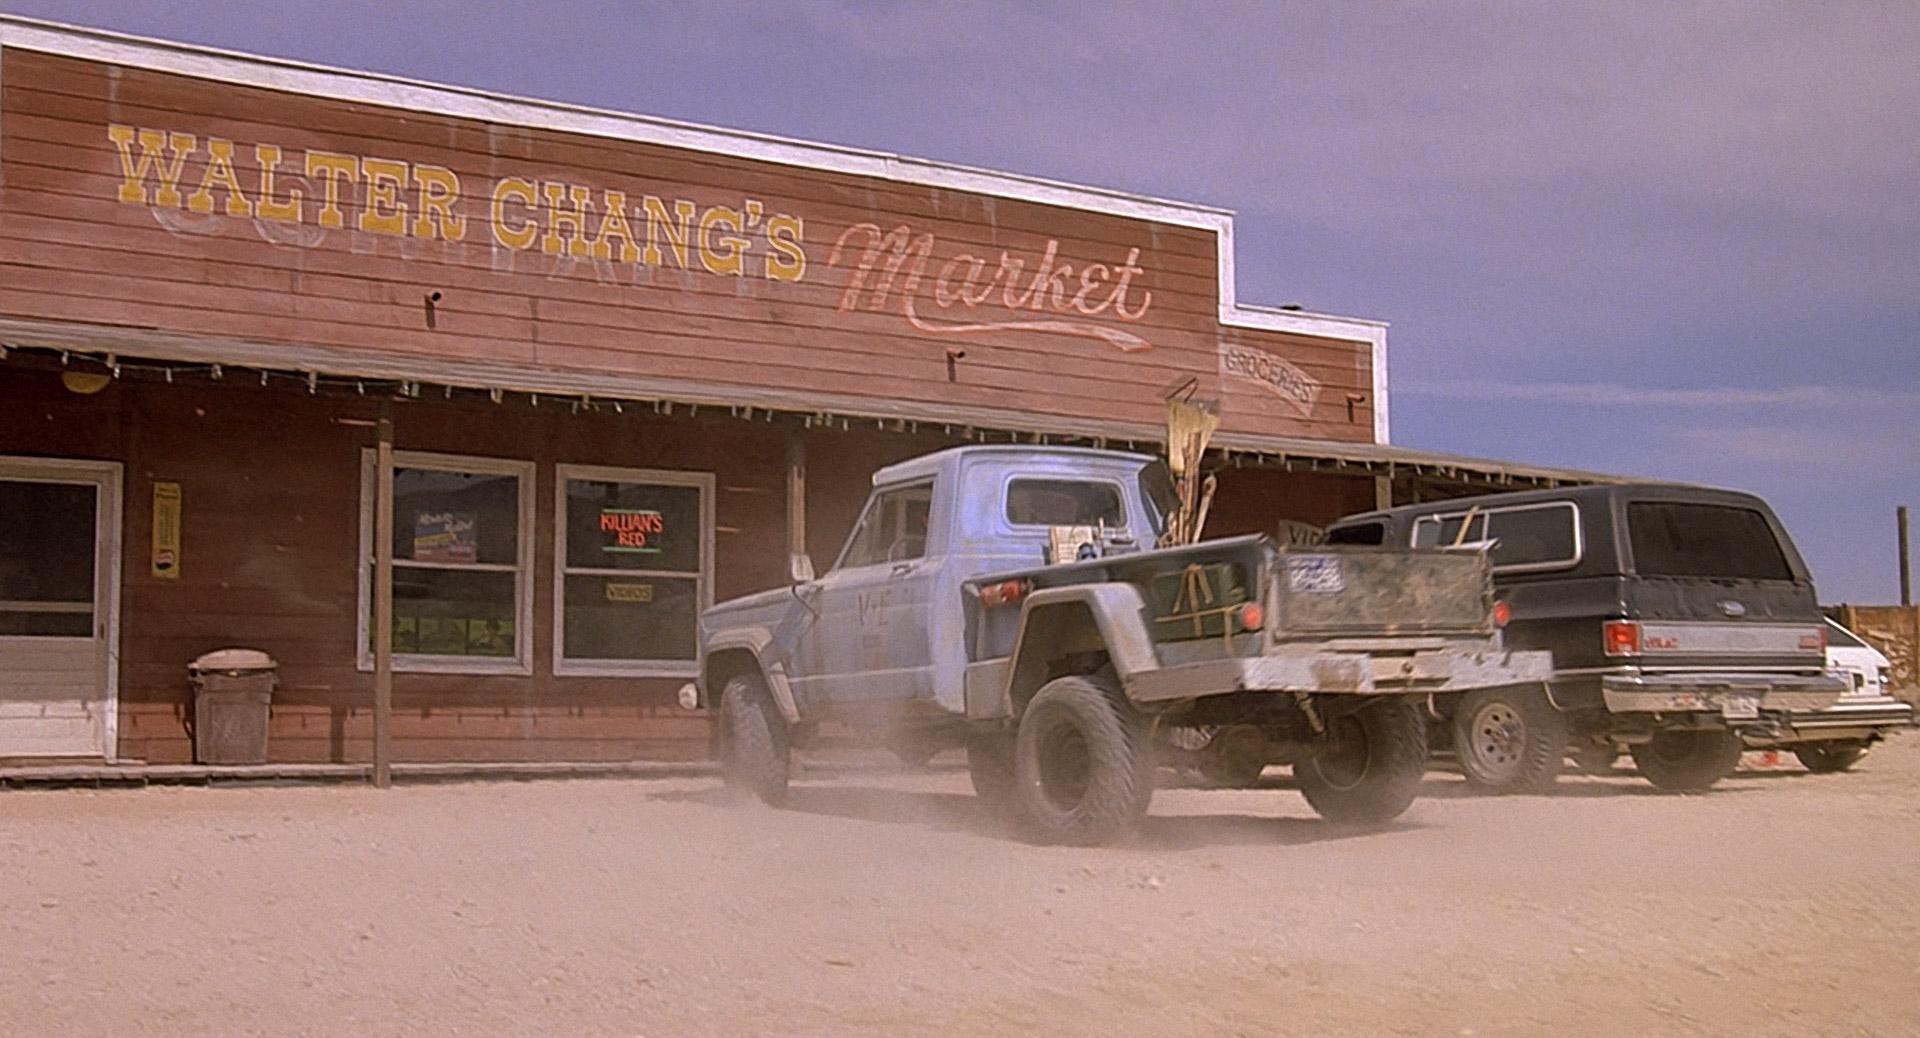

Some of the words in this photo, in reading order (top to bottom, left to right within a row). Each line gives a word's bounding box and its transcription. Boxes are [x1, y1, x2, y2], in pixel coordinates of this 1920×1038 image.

[107, 123, 467, 242] WALTER
[491, 177, 806, 281] CHANG'S
[827, 223, 1153, 351] Market
[1225, 349, 1313, 404] GROCERIES
[600, 513, 663, 533] KILLIAN'S
[619, 531, 646, 546] RED
